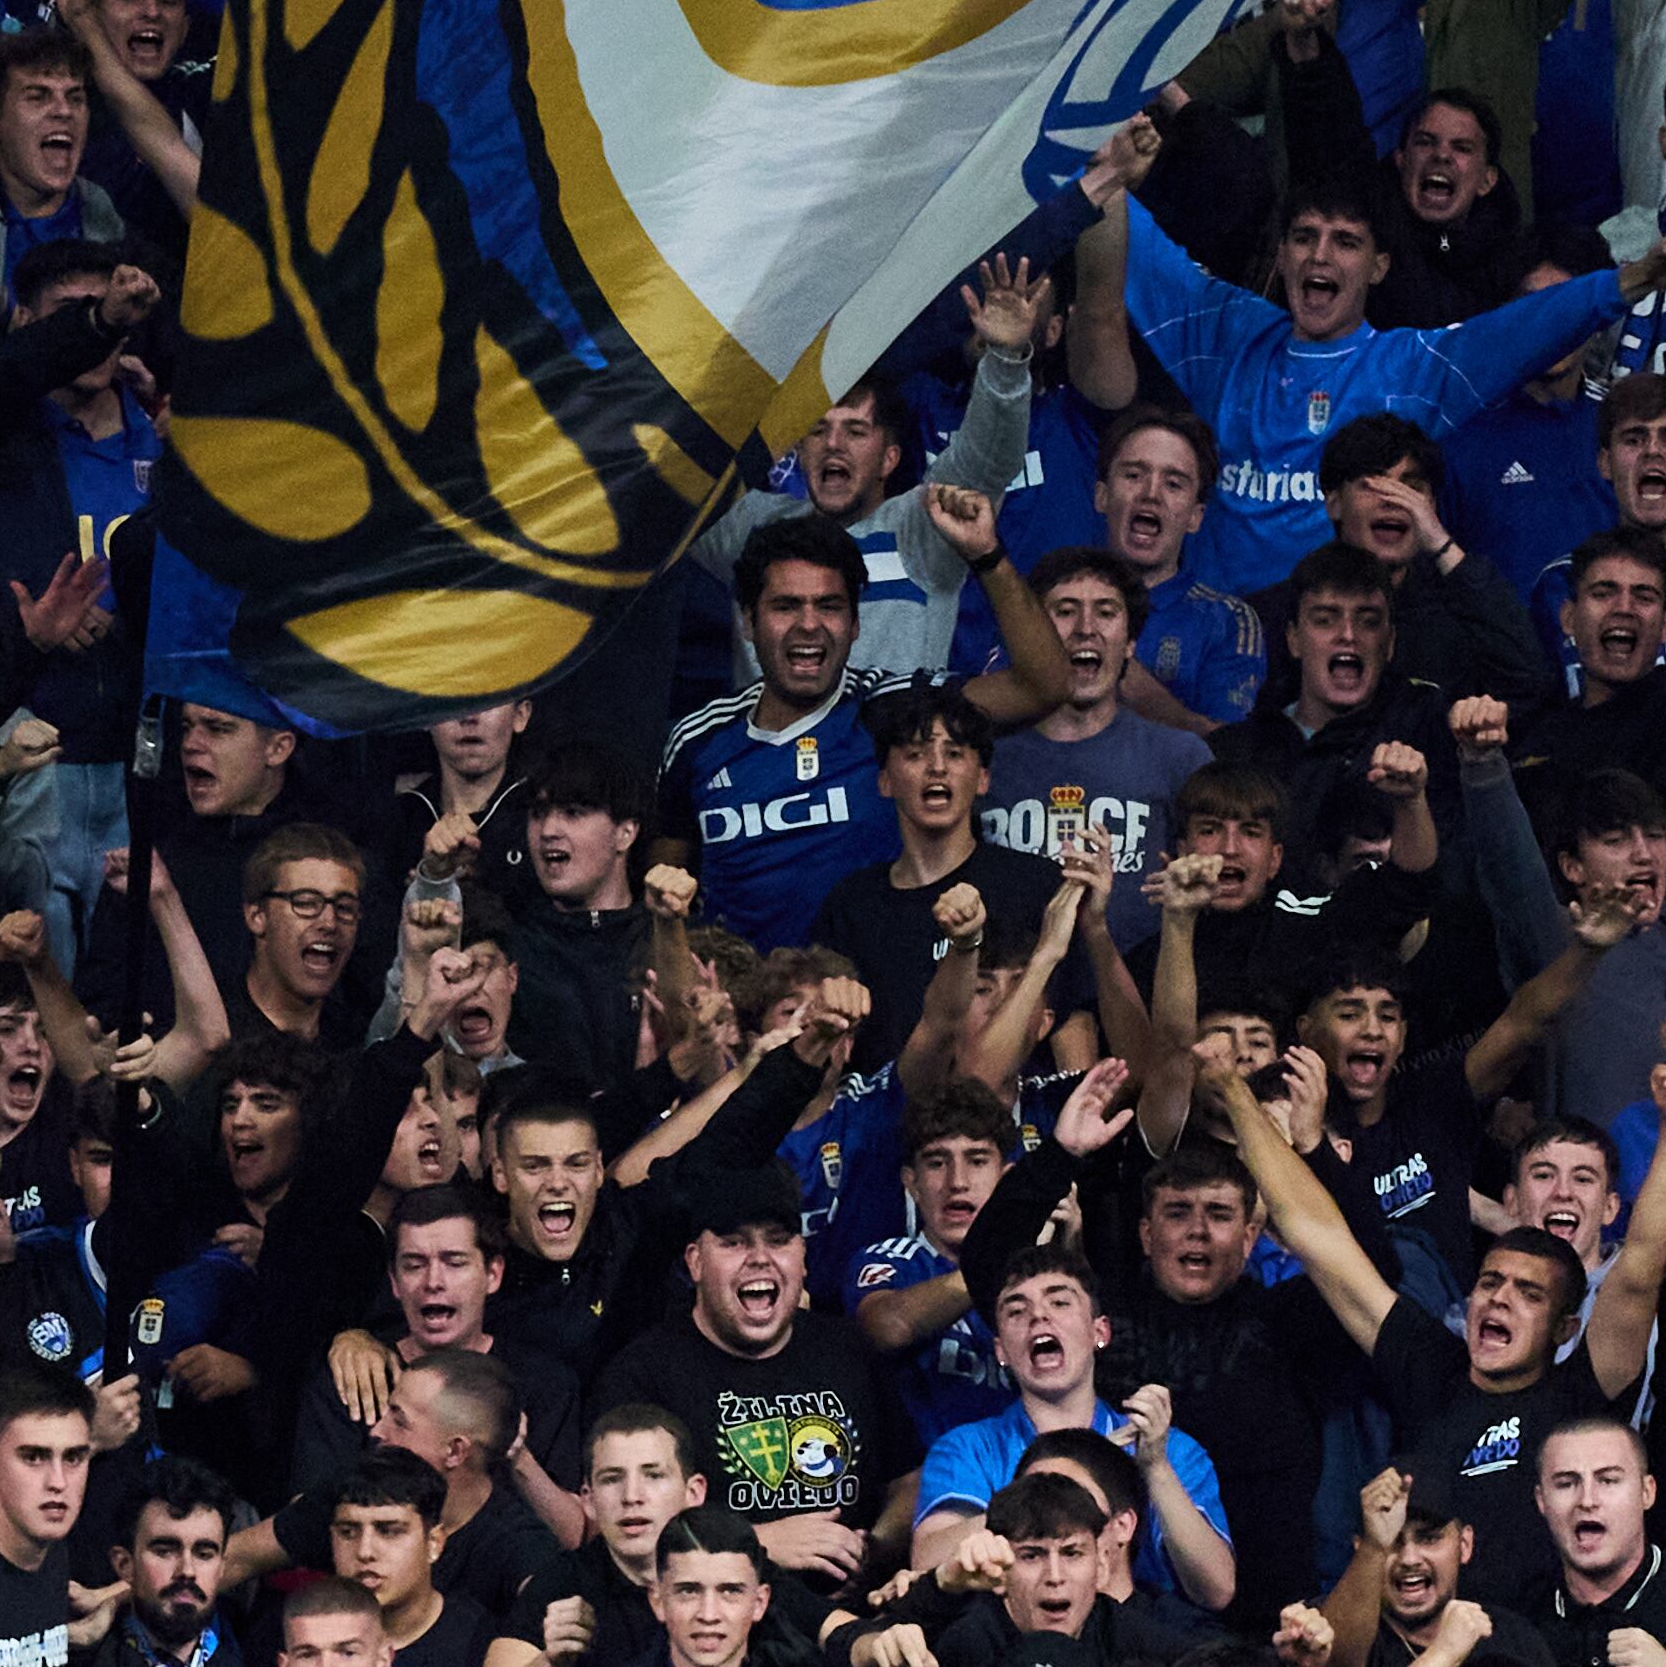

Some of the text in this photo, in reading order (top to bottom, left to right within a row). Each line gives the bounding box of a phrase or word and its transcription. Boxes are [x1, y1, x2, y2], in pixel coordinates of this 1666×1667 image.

[698, 785, 850, 845] DIGI
[1372, 1152, 1428, 1197] ULTRAS
[1379, 1171, 1433, 1211] OVIEDO
[717, 1390, 846, 1425] ŽILINA
[728, 1476, 861, 1510] OVIEDO
